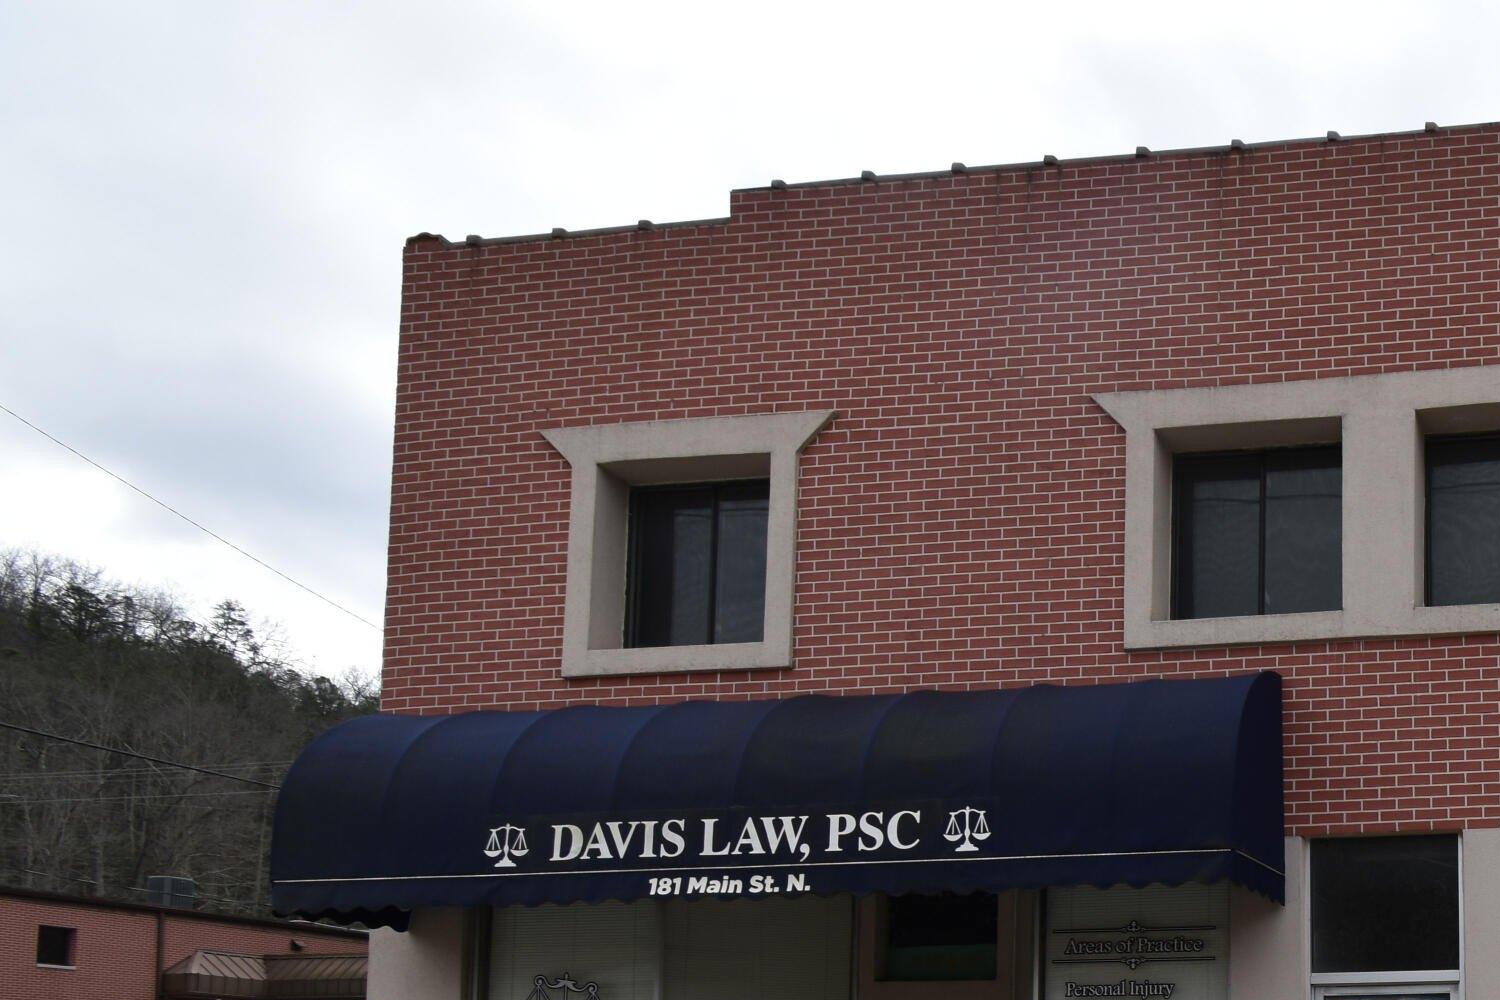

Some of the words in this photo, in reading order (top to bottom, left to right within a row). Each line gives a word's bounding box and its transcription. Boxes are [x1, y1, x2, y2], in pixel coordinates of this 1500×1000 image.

[549, 818, 686, 862] DAVIS
[699, 814, 811, 863] LAW,
[825, 810, 922, 852] PSC
[648, 877, 682, 896] 181
[687, 875, 743, 895] Main
[748, 875, 780, 894] St.
[786, 873, 811, 892] N.
[1065, 938, 1112, 954] Areas
[1115, 937, 1133, 953] of
[1136, 936, 1203, 952] Practice
[1065, 979, 1126, 998] Personal
[1129, 980, 1175, 999] Injury
